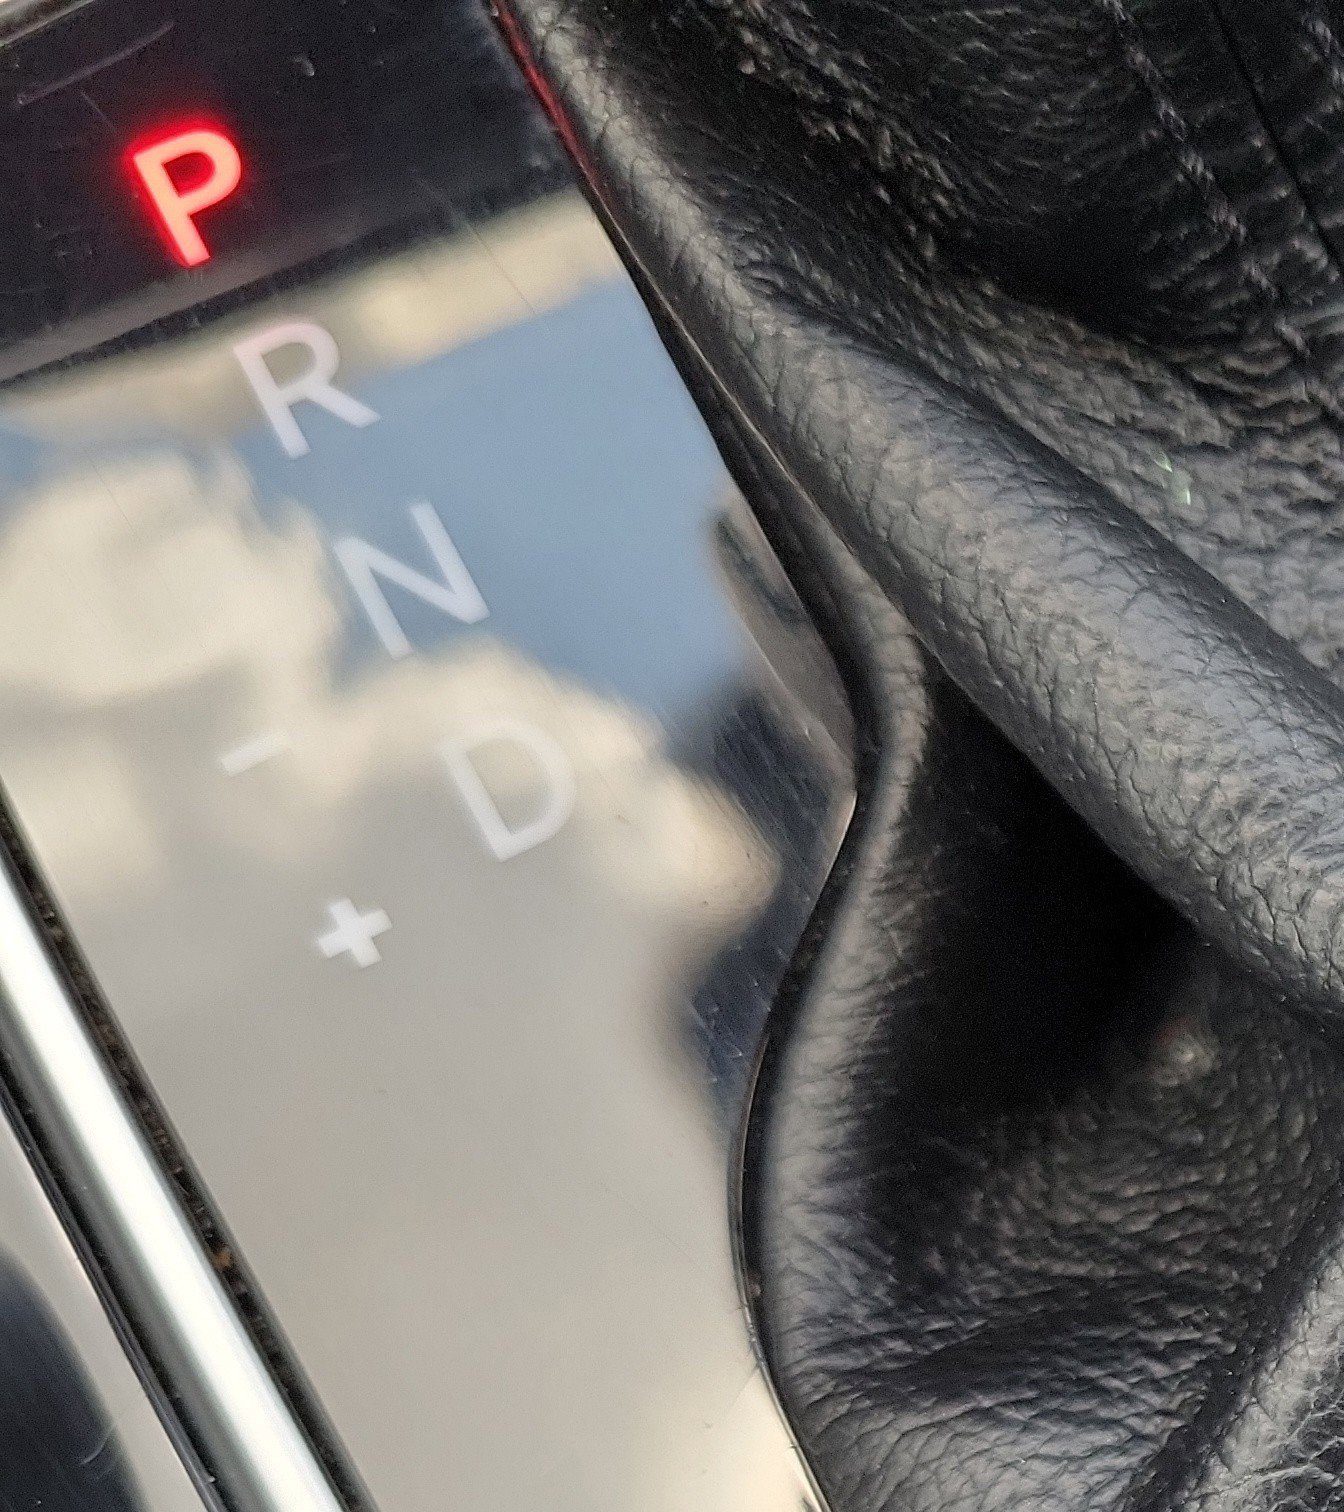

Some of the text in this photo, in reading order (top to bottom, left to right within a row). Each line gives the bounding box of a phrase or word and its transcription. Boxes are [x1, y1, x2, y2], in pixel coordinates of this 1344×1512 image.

[132, 128, 243, 267] P
[233, 321, 381, 458] R
[333, 499, 491, 658] N
[443, 718, 579, 863] D
